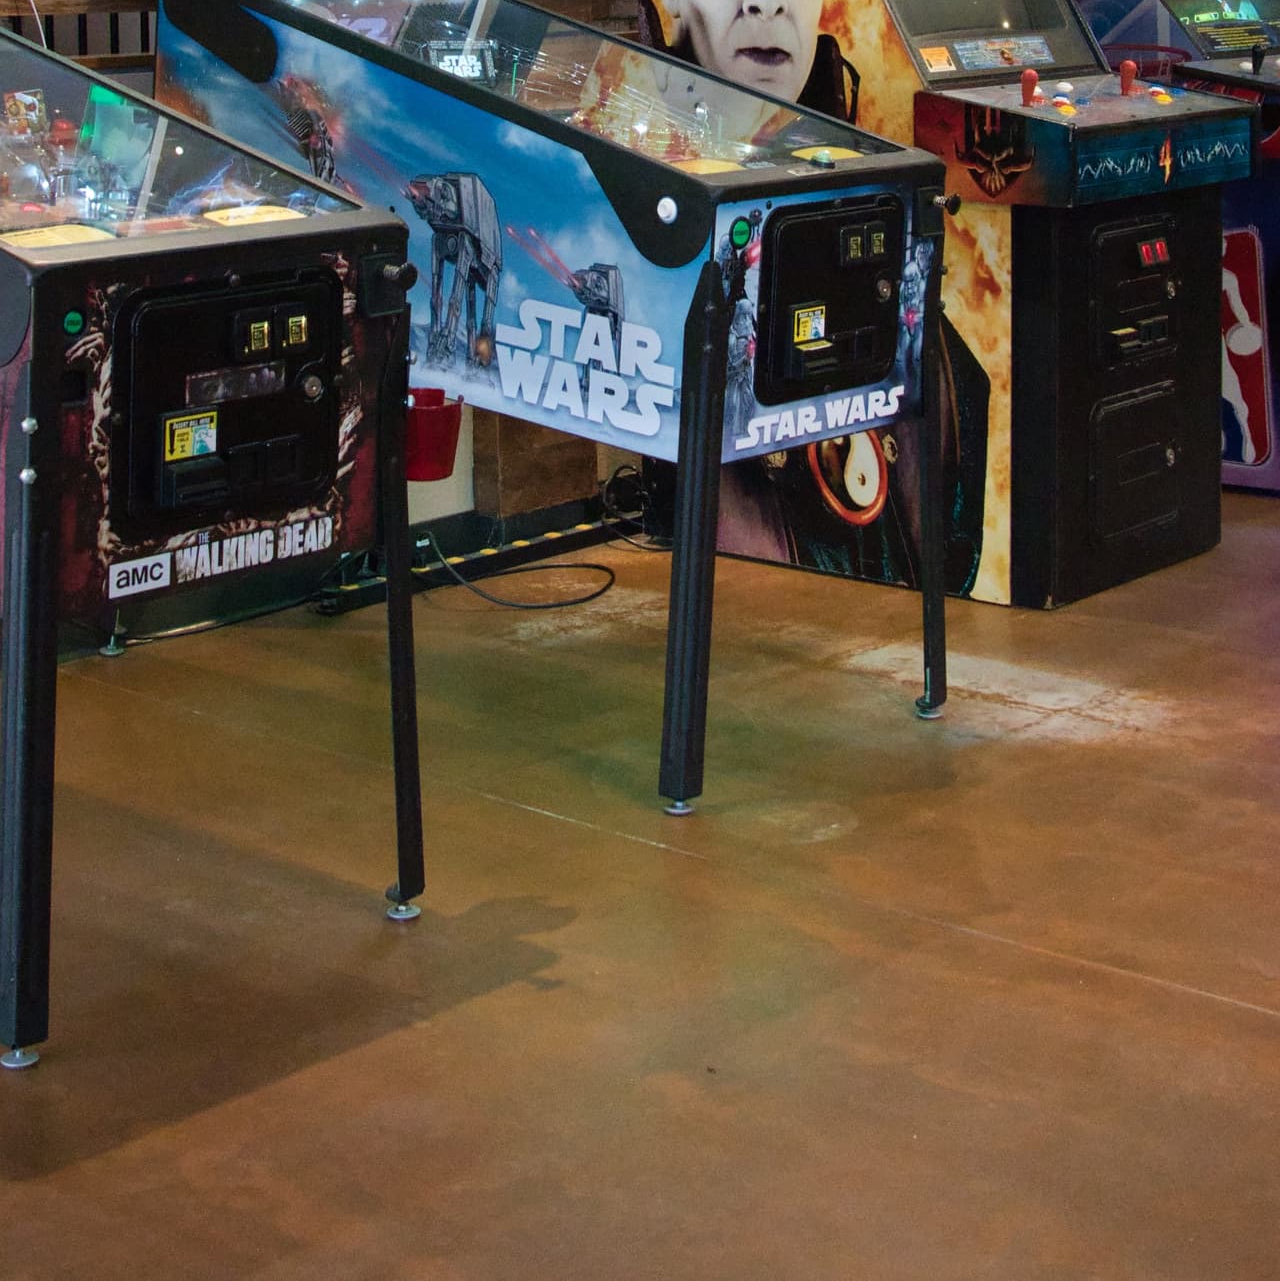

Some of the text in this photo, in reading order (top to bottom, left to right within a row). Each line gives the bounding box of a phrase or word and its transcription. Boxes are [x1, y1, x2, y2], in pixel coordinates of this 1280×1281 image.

[439, 55, 482, 68] STAR
[496, 299, 675, 386] STAR
[495, 343, 674, 438] WARS
[735, 384, 906, 451] STAR WARS
[175, 529, 275, 584] WALKING
[278, 516, 334, 560] DEAD
[198, 531, 211, 545] THE
